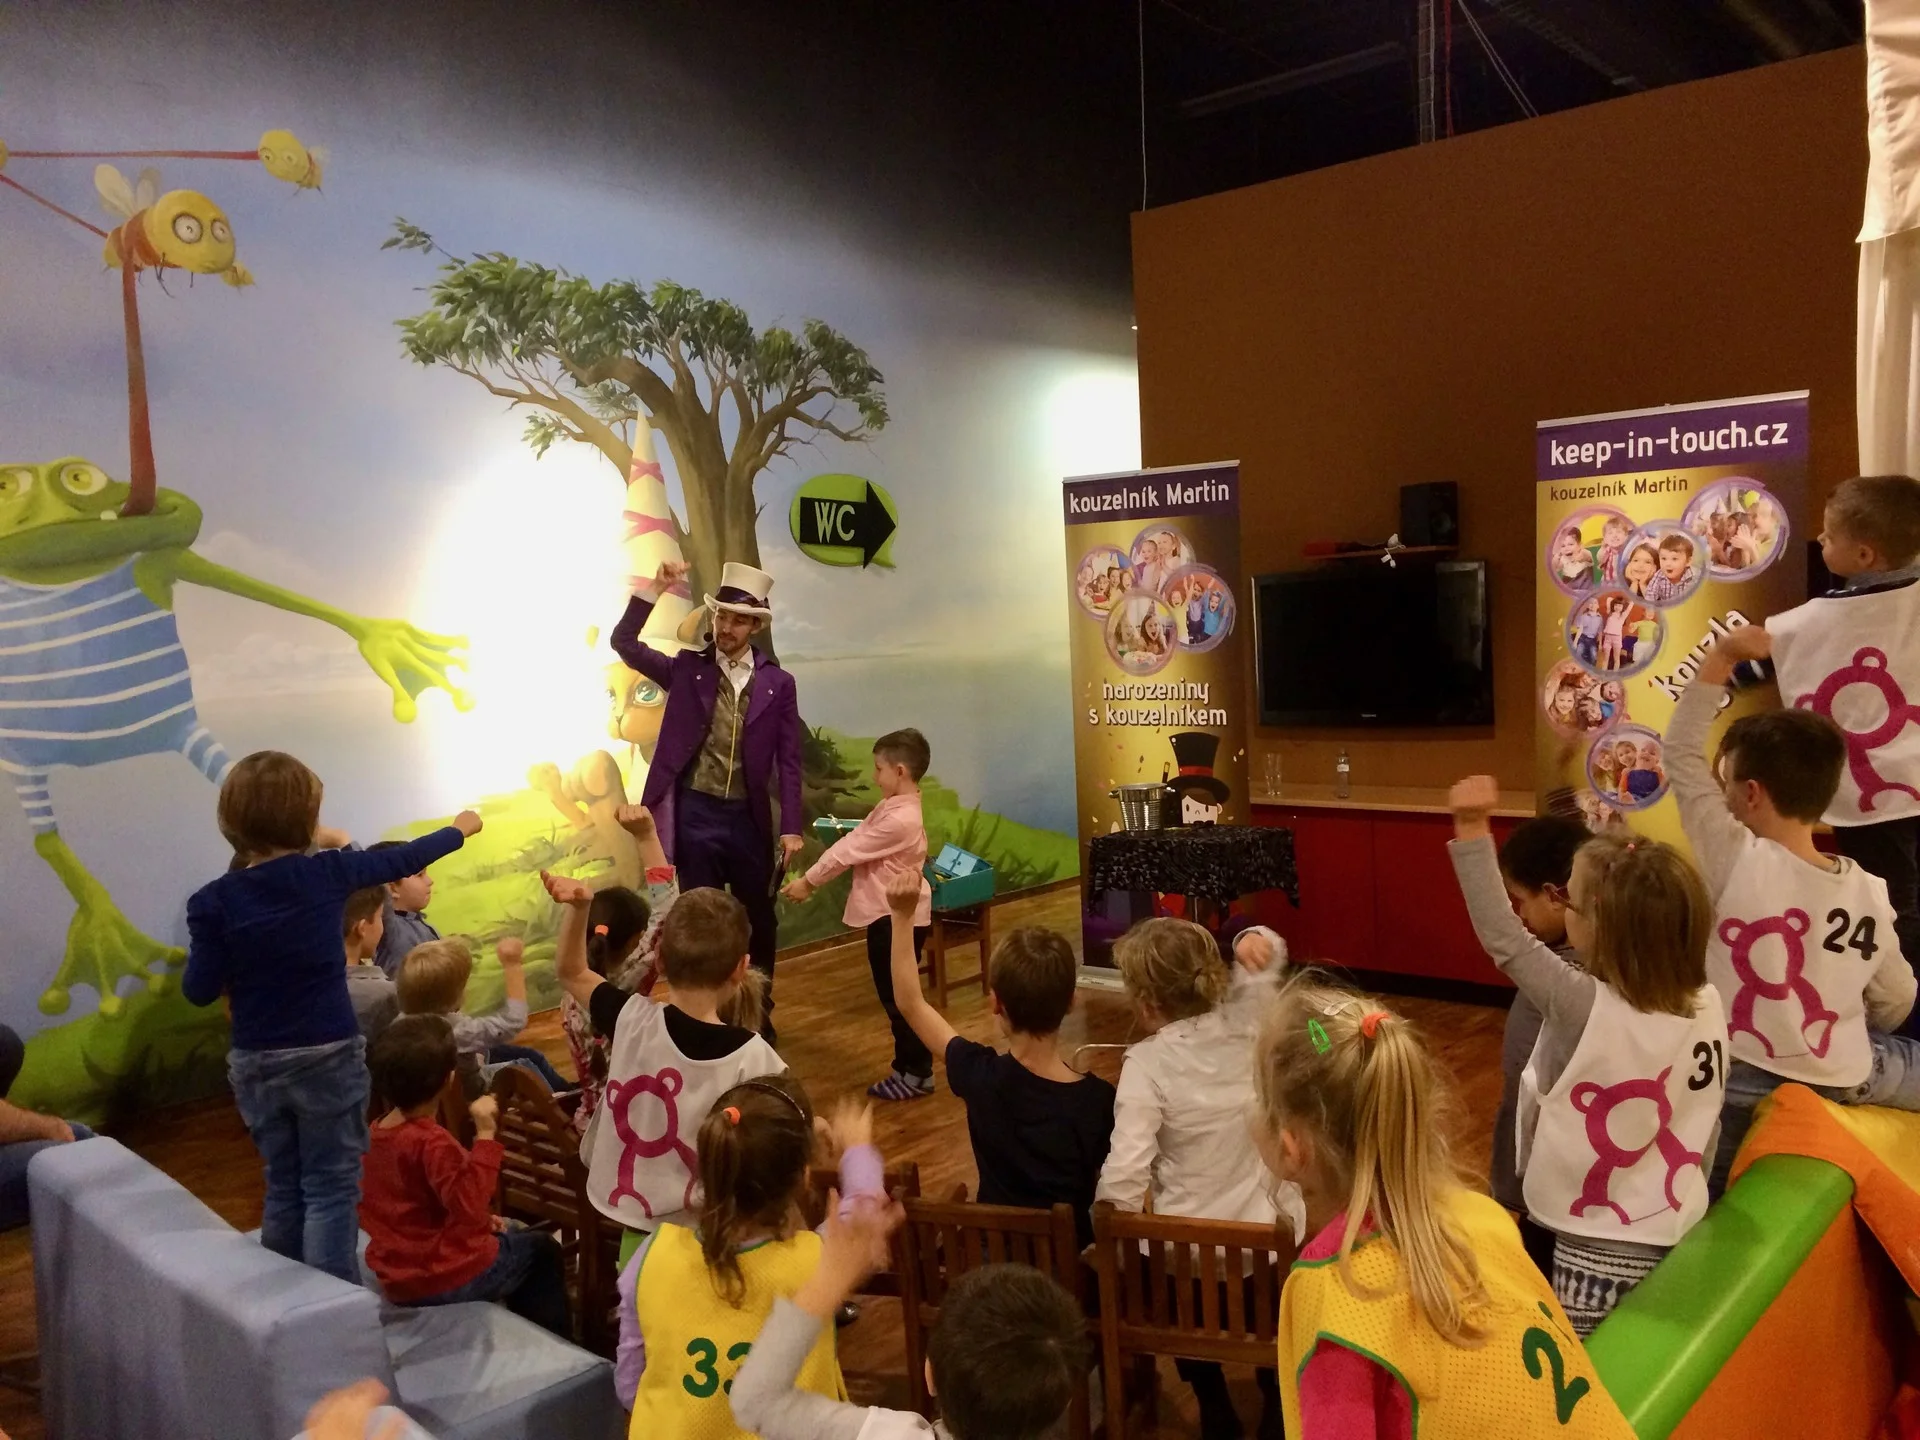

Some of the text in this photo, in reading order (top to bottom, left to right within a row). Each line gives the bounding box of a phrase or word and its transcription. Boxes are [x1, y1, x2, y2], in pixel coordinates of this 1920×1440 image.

[1550, 420, 1789, 468] keep-in-touch.cz
[1070, 479, 1230, 514] kouzelník Martin
[1550, 475, 1689, 501] kouzelník Martin
[814, 501, 856, 543] WC
[1102, 677, 1211, 705] narozeniny
[1088, 703, 1228, 726] s kouzelníkem
[1822, 908, 1879, 961] 24
[1521, 1300, 1591, 1425] 2
